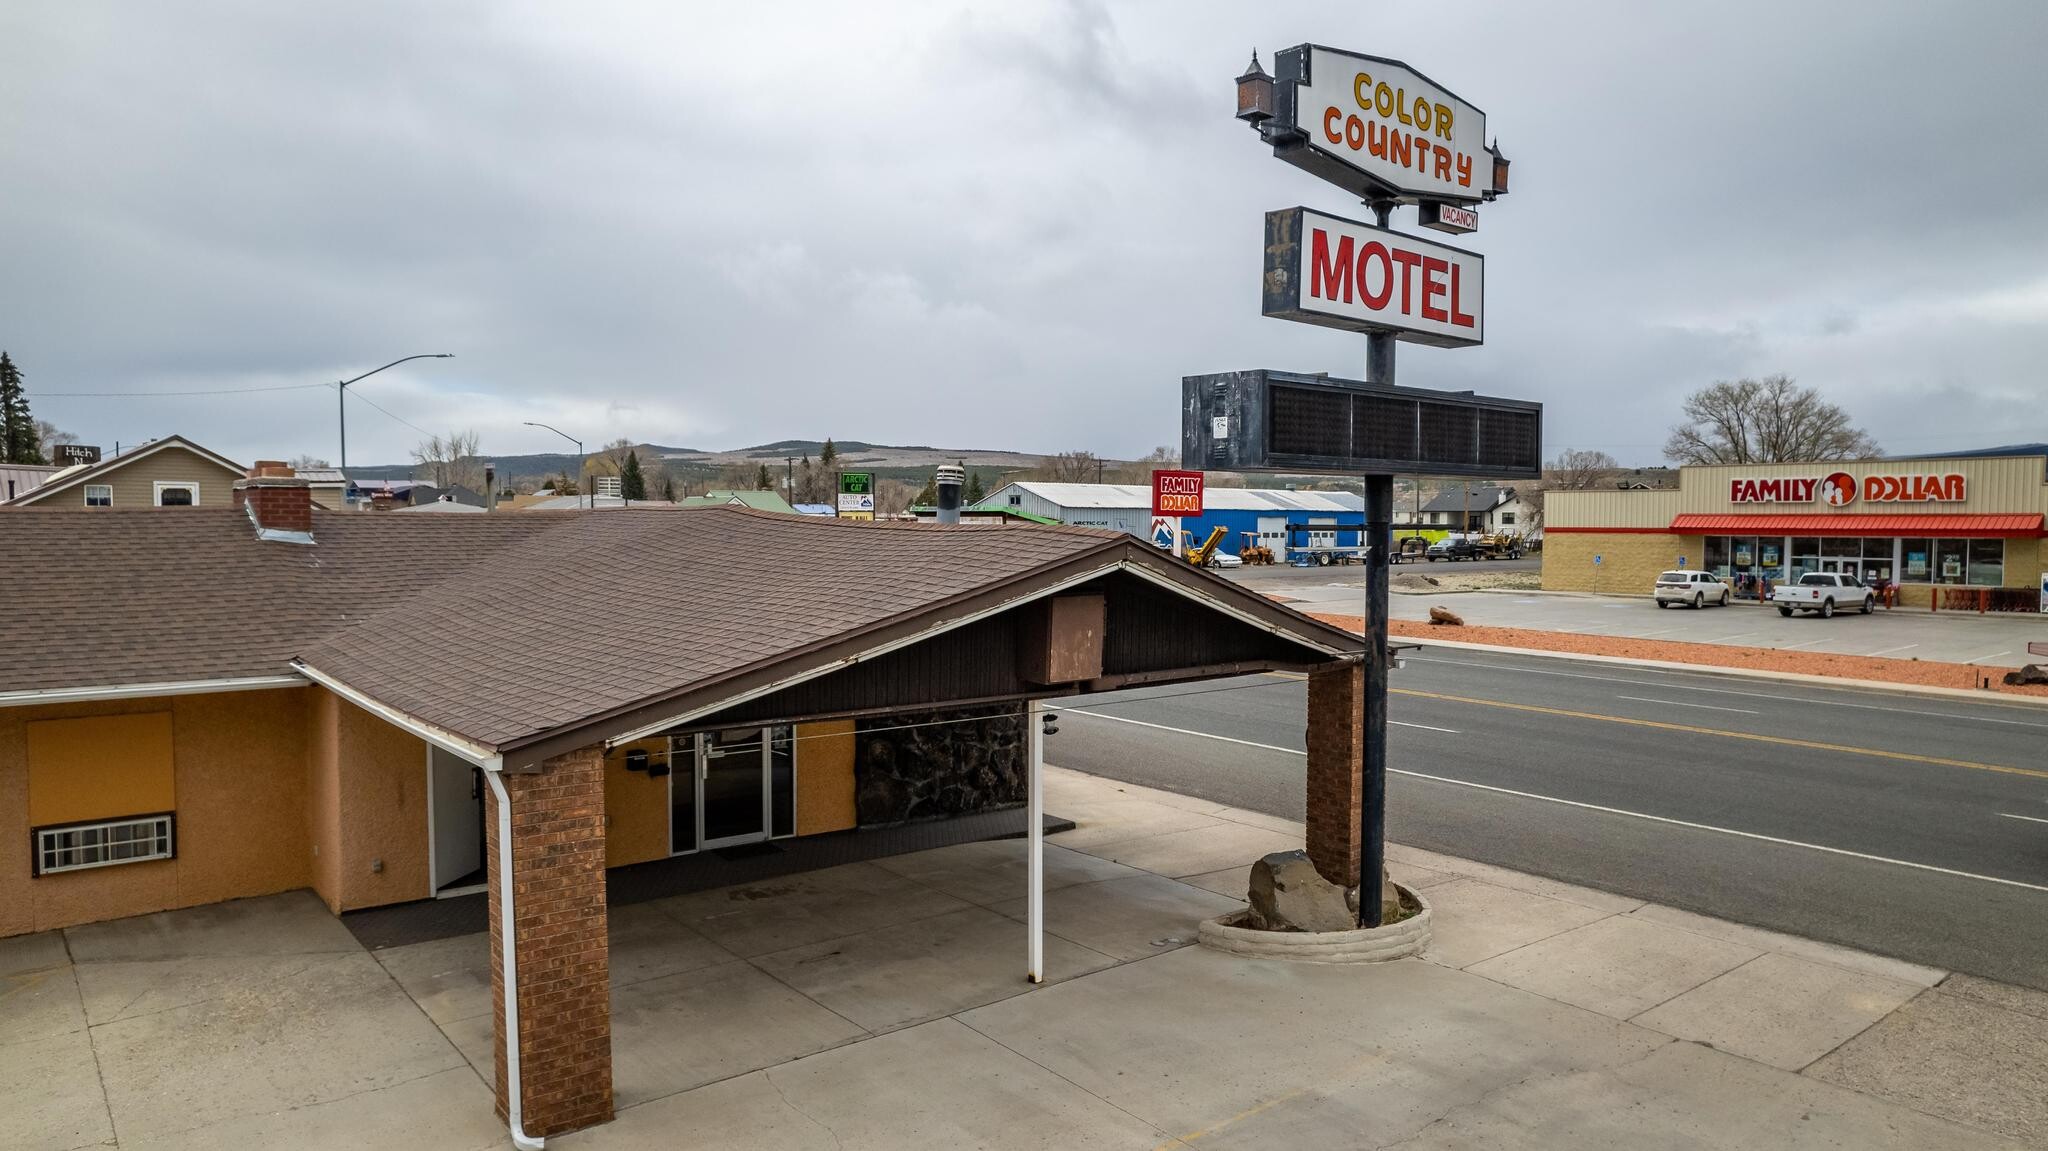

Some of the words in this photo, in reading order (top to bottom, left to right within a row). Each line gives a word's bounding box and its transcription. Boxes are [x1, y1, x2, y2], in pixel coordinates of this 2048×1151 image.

[1354, 72, 1454, 141] COLOR
[1324, 106, 1472, 188] COUNTRY
[1442, 207, 1477, 228] VACANCY
[1311, 228, 1474, 328] MOTEL
[65, 446, 93, 458] Hitch
[845, 475, 868, 483] ARCTIC
[1161, 476, 1200, 494] FAMILY
[1730, 477, 1819, 503] FAMILY
[1863, 473, 1967, 503] DOLLAR
[1161, 494, 1200, 511] DOLLAR
